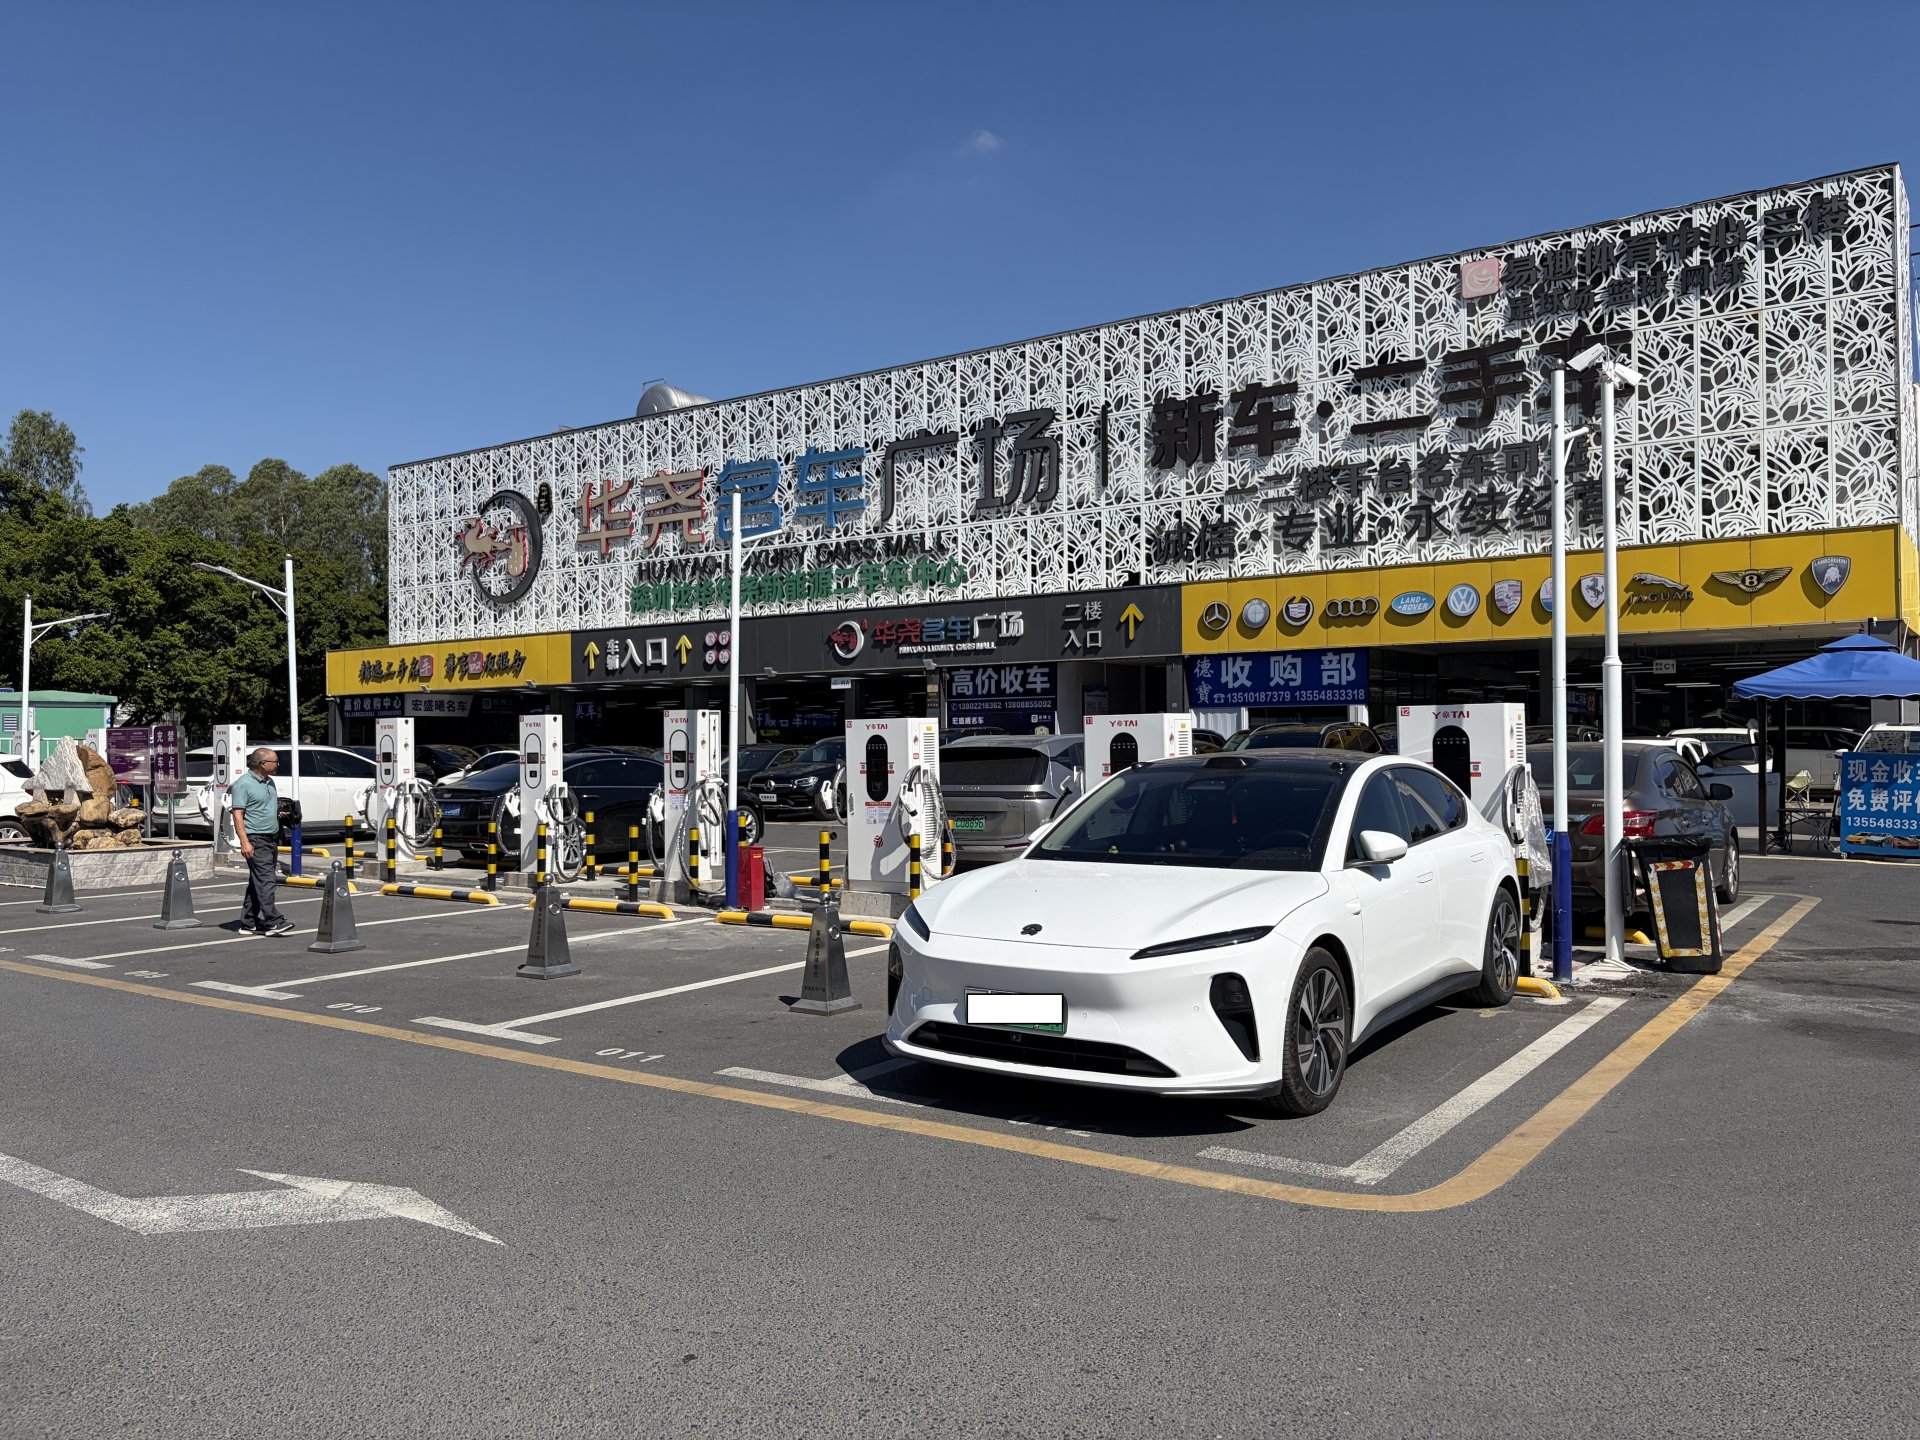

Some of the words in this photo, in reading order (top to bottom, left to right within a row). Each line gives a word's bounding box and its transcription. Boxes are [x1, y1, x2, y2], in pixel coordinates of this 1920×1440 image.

[577, 408, 1060, 557] 华尧名车广场
[1402, 603, 1428, 611] ROVER
[1629, 591, 1694, 604] JAGUAR
[1064, 601, 1103, 622] 二楼
[874, 610, 1024, 645] 华尧名车广场
[1064, 630, 1102, 648] 入口
[1221, 652, 1357, 688] 收购部
[1663, 662, 1675, 670] C1
[951, 665, 1050, 696] 高价收车
[344, 696, 402, 711] 高价收购中心
[1227, 690, 1290, 703] 13510187379
[1294, 689, 1365, 702] 13554833318
[156, 730, 165, 781] 充电车位
[167, 730, 175, 781] 禁止占用
[1847, 759, 1920, 785] 现金收
[1846, 787, 1920, 814] 免费评
[1846, 816, 1920, 830] 135548333
[595, 1048, 666, 1062] 011
